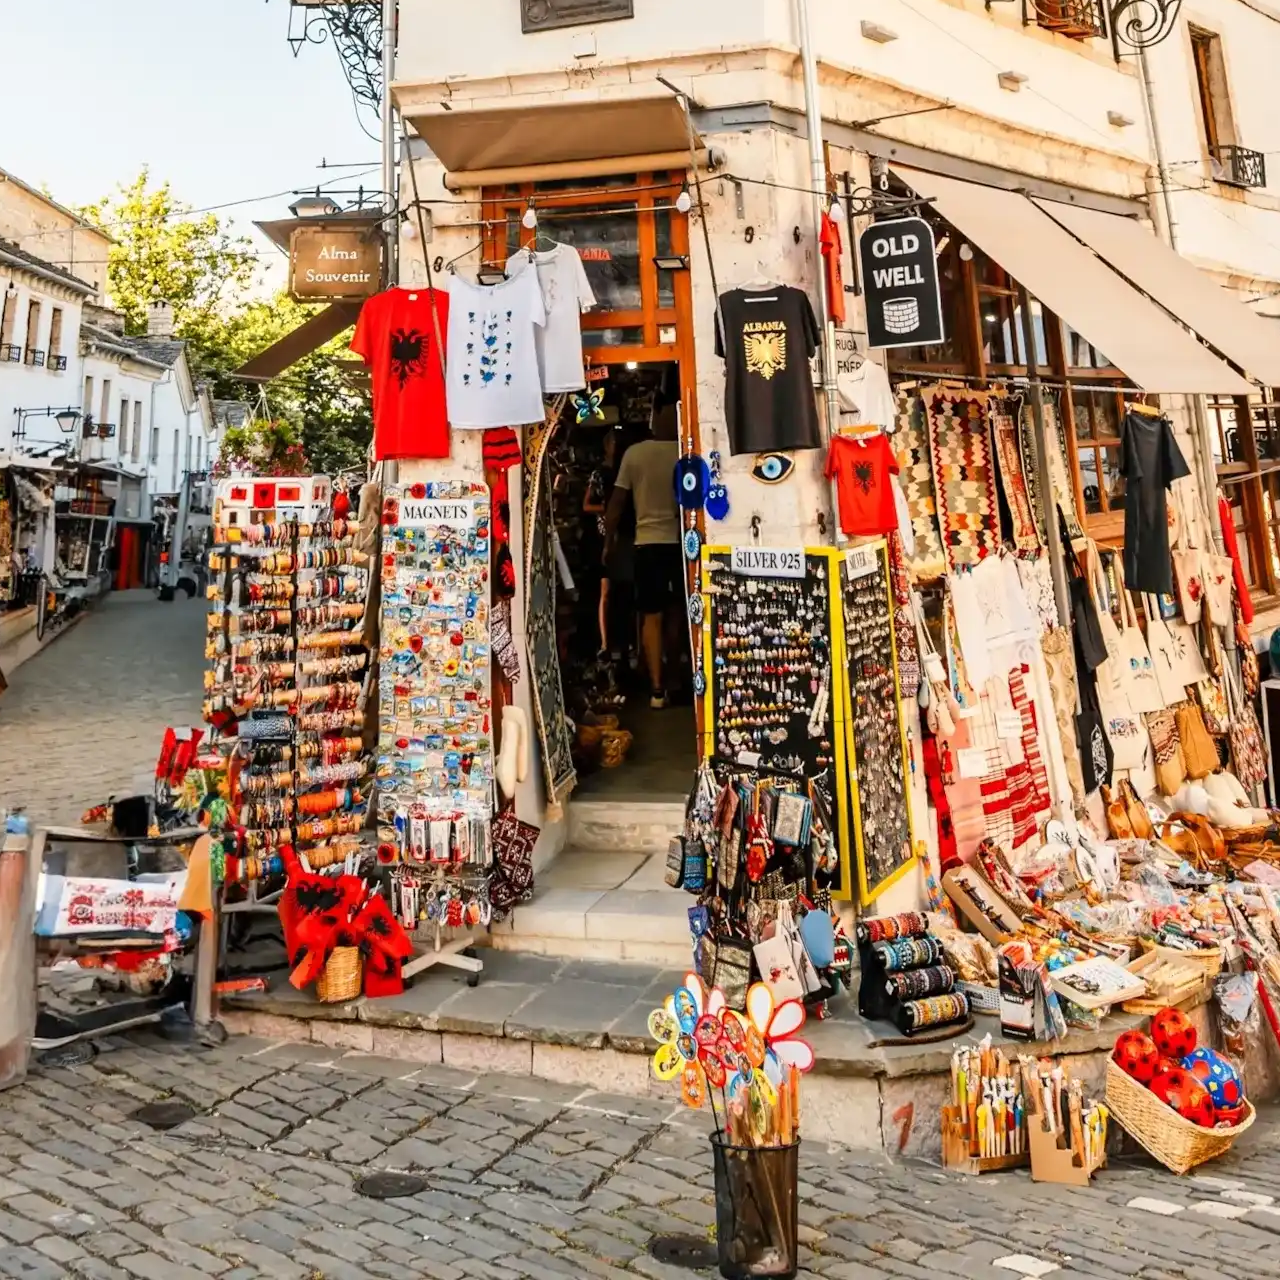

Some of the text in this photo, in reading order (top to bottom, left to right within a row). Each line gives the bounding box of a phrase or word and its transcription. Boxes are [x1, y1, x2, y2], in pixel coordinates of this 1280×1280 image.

[318, 245, 358, 260] Alma
[872, 234, 920, 258] OLD
[306, 268, 371, 283] Souvenir
[873, 264, 925, 289] WELL
[742, 320, 787, 333] ALBANIA
[835, 339, 858, 352] RUGA
[403, 504, 468, 520] MAGNETS
[735, 551, 801, 570] SILVER 925
